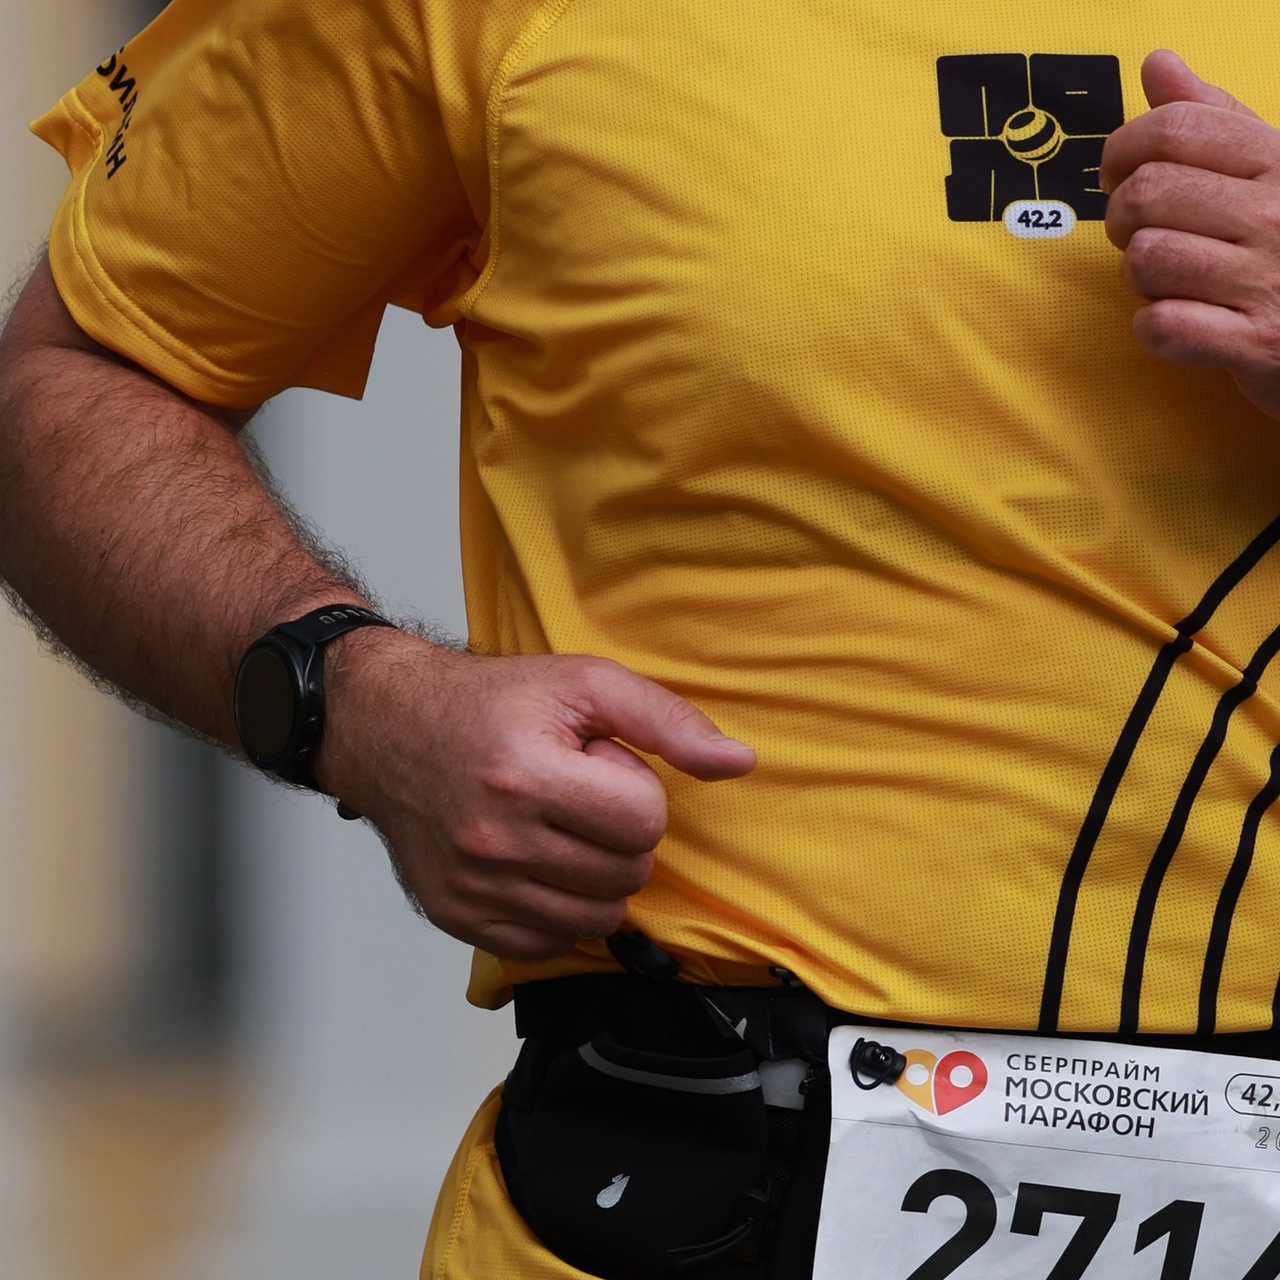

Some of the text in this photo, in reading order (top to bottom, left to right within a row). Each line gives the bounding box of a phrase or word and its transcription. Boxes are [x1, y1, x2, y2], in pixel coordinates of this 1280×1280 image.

[1017, 210, 1063, 231] 42,2
[1006, 1053, 1160, 1083] СБЕРПРАЙМ
[1005, 1076, 1209, 1116] МОСКОВСКИЙ
[1004, 1102, 1156, 1139] МАРАФОН
